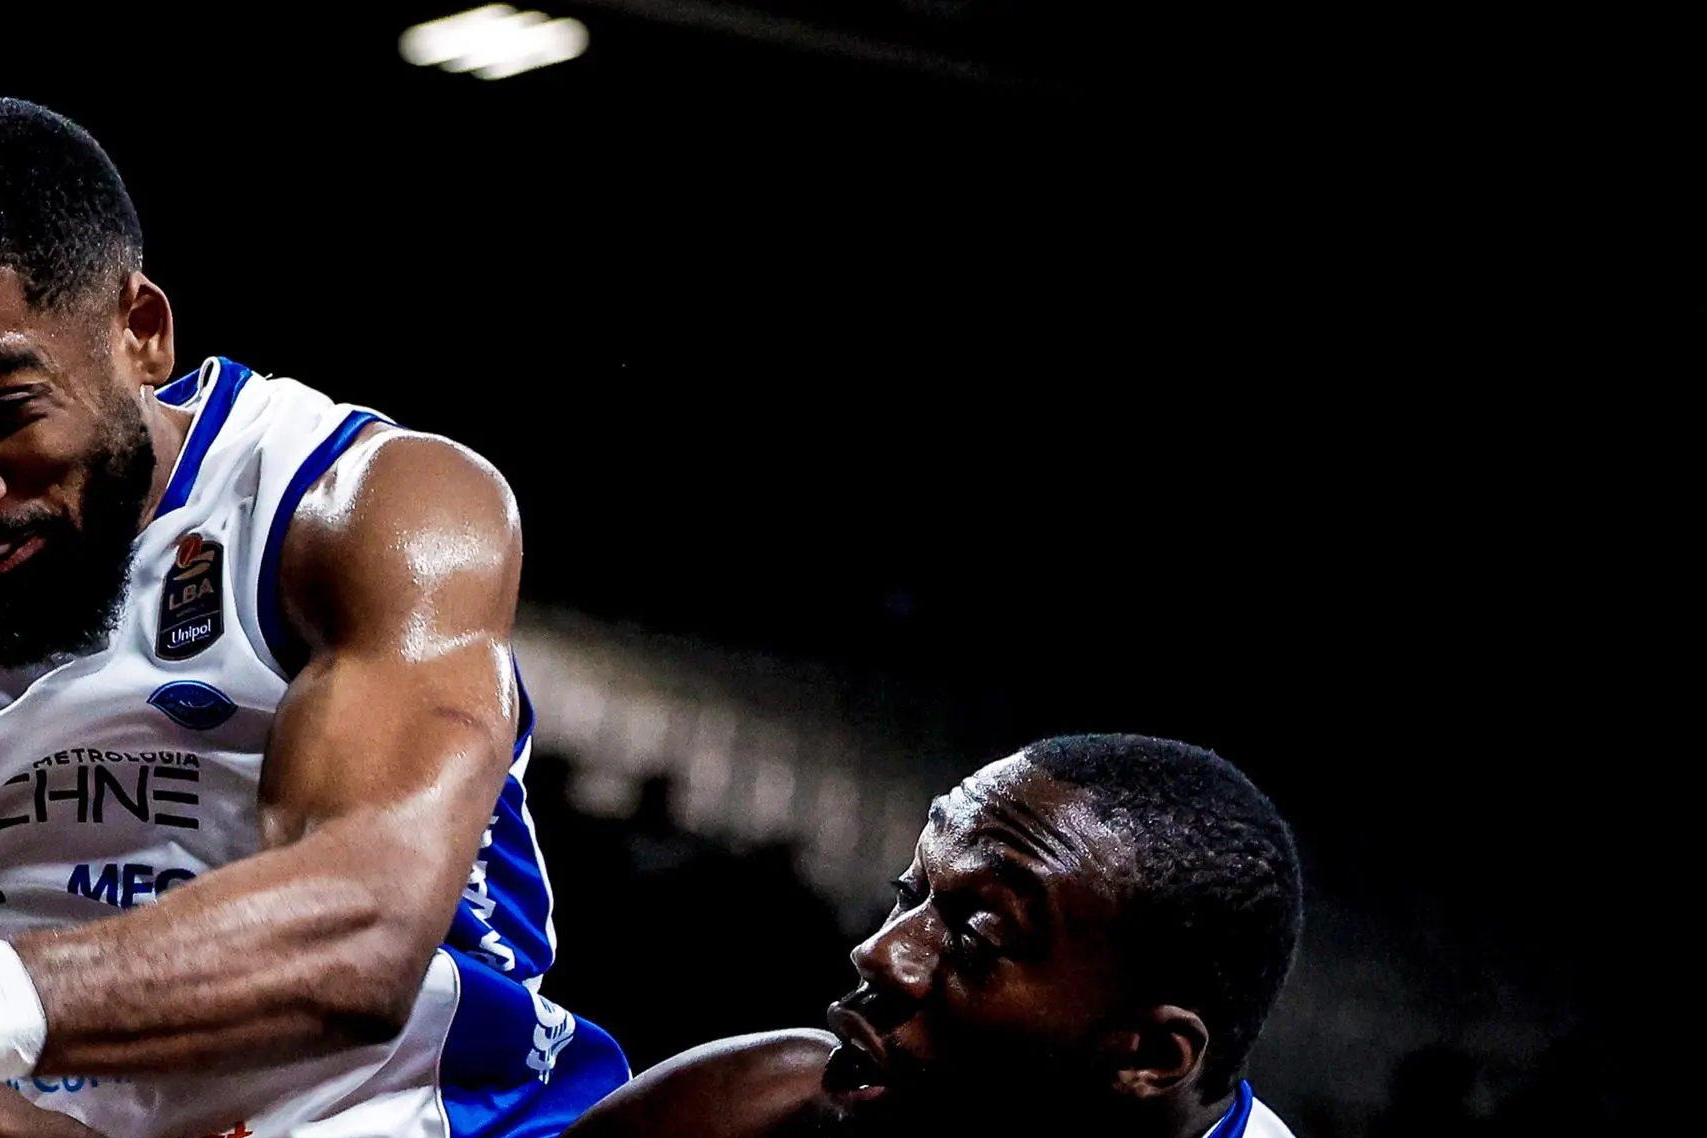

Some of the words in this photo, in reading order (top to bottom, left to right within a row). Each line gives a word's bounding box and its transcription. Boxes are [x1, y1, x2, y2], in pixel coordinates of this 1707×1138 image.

[168, 577, 215, 611] LBA
[171, 618, 212, 644] Unipol
[32, 747, 200, 769] METROLOGIA
